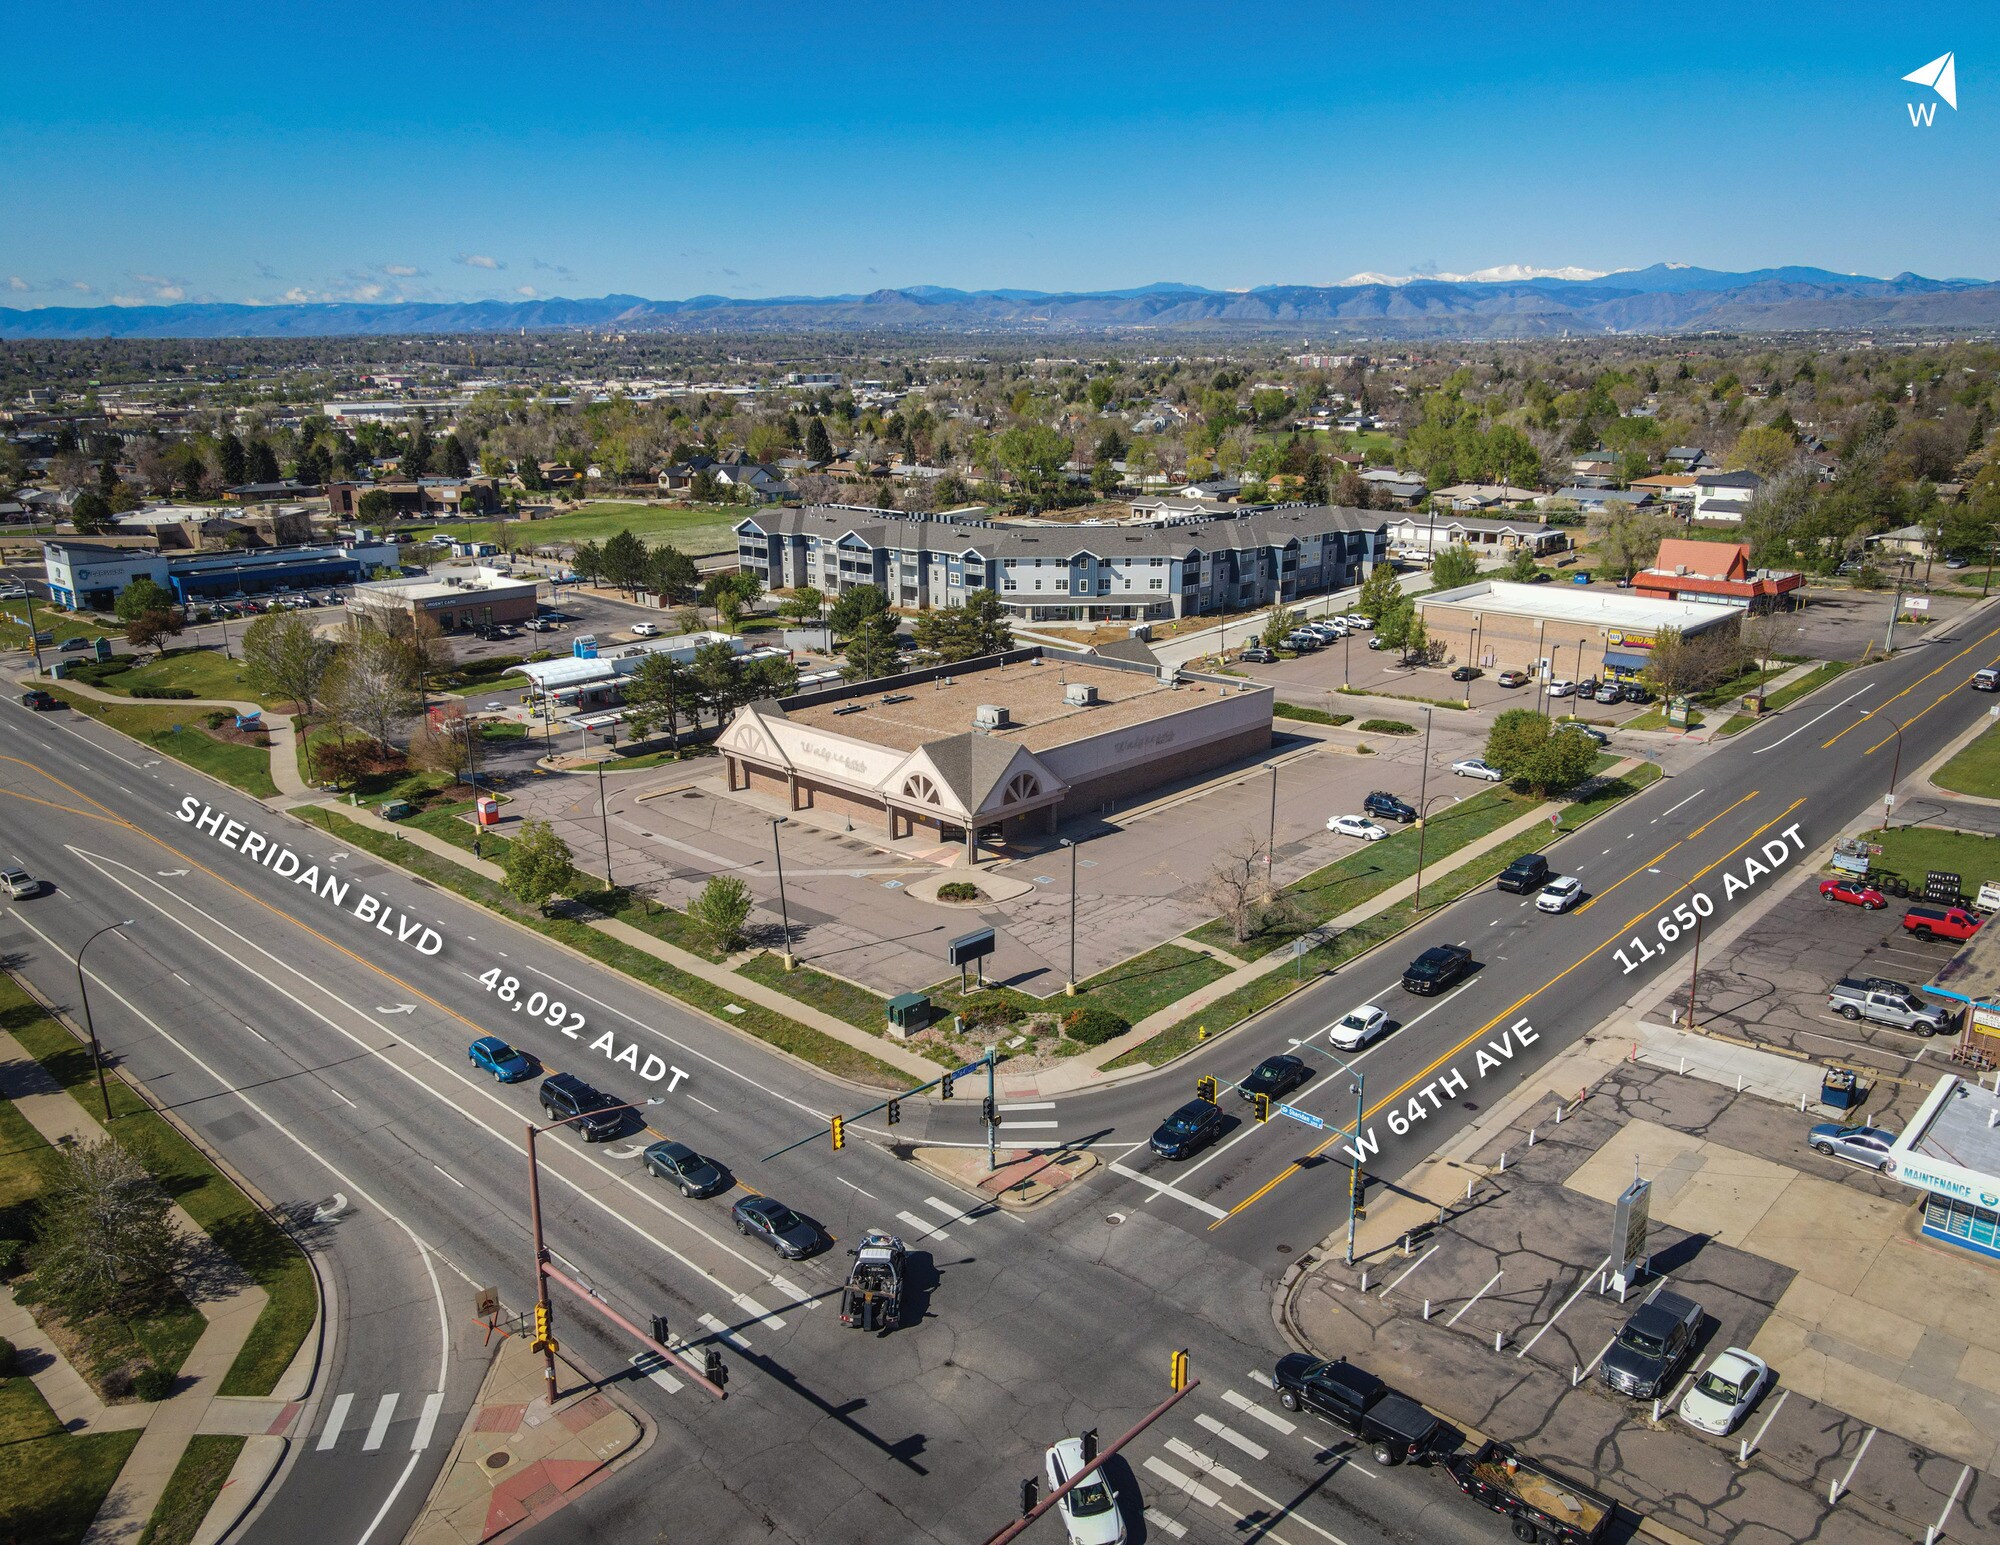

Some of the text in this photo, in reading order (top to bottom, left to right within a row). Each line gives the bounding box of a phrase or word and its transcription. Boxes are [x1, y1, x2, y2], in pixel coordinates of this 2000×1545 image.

[1625, 634, 1643, 644] AUTO
[1289, 1108, 1310, 1122] Sheridan
[1904, 1167, 1971, 1197] MAINTENANCE
